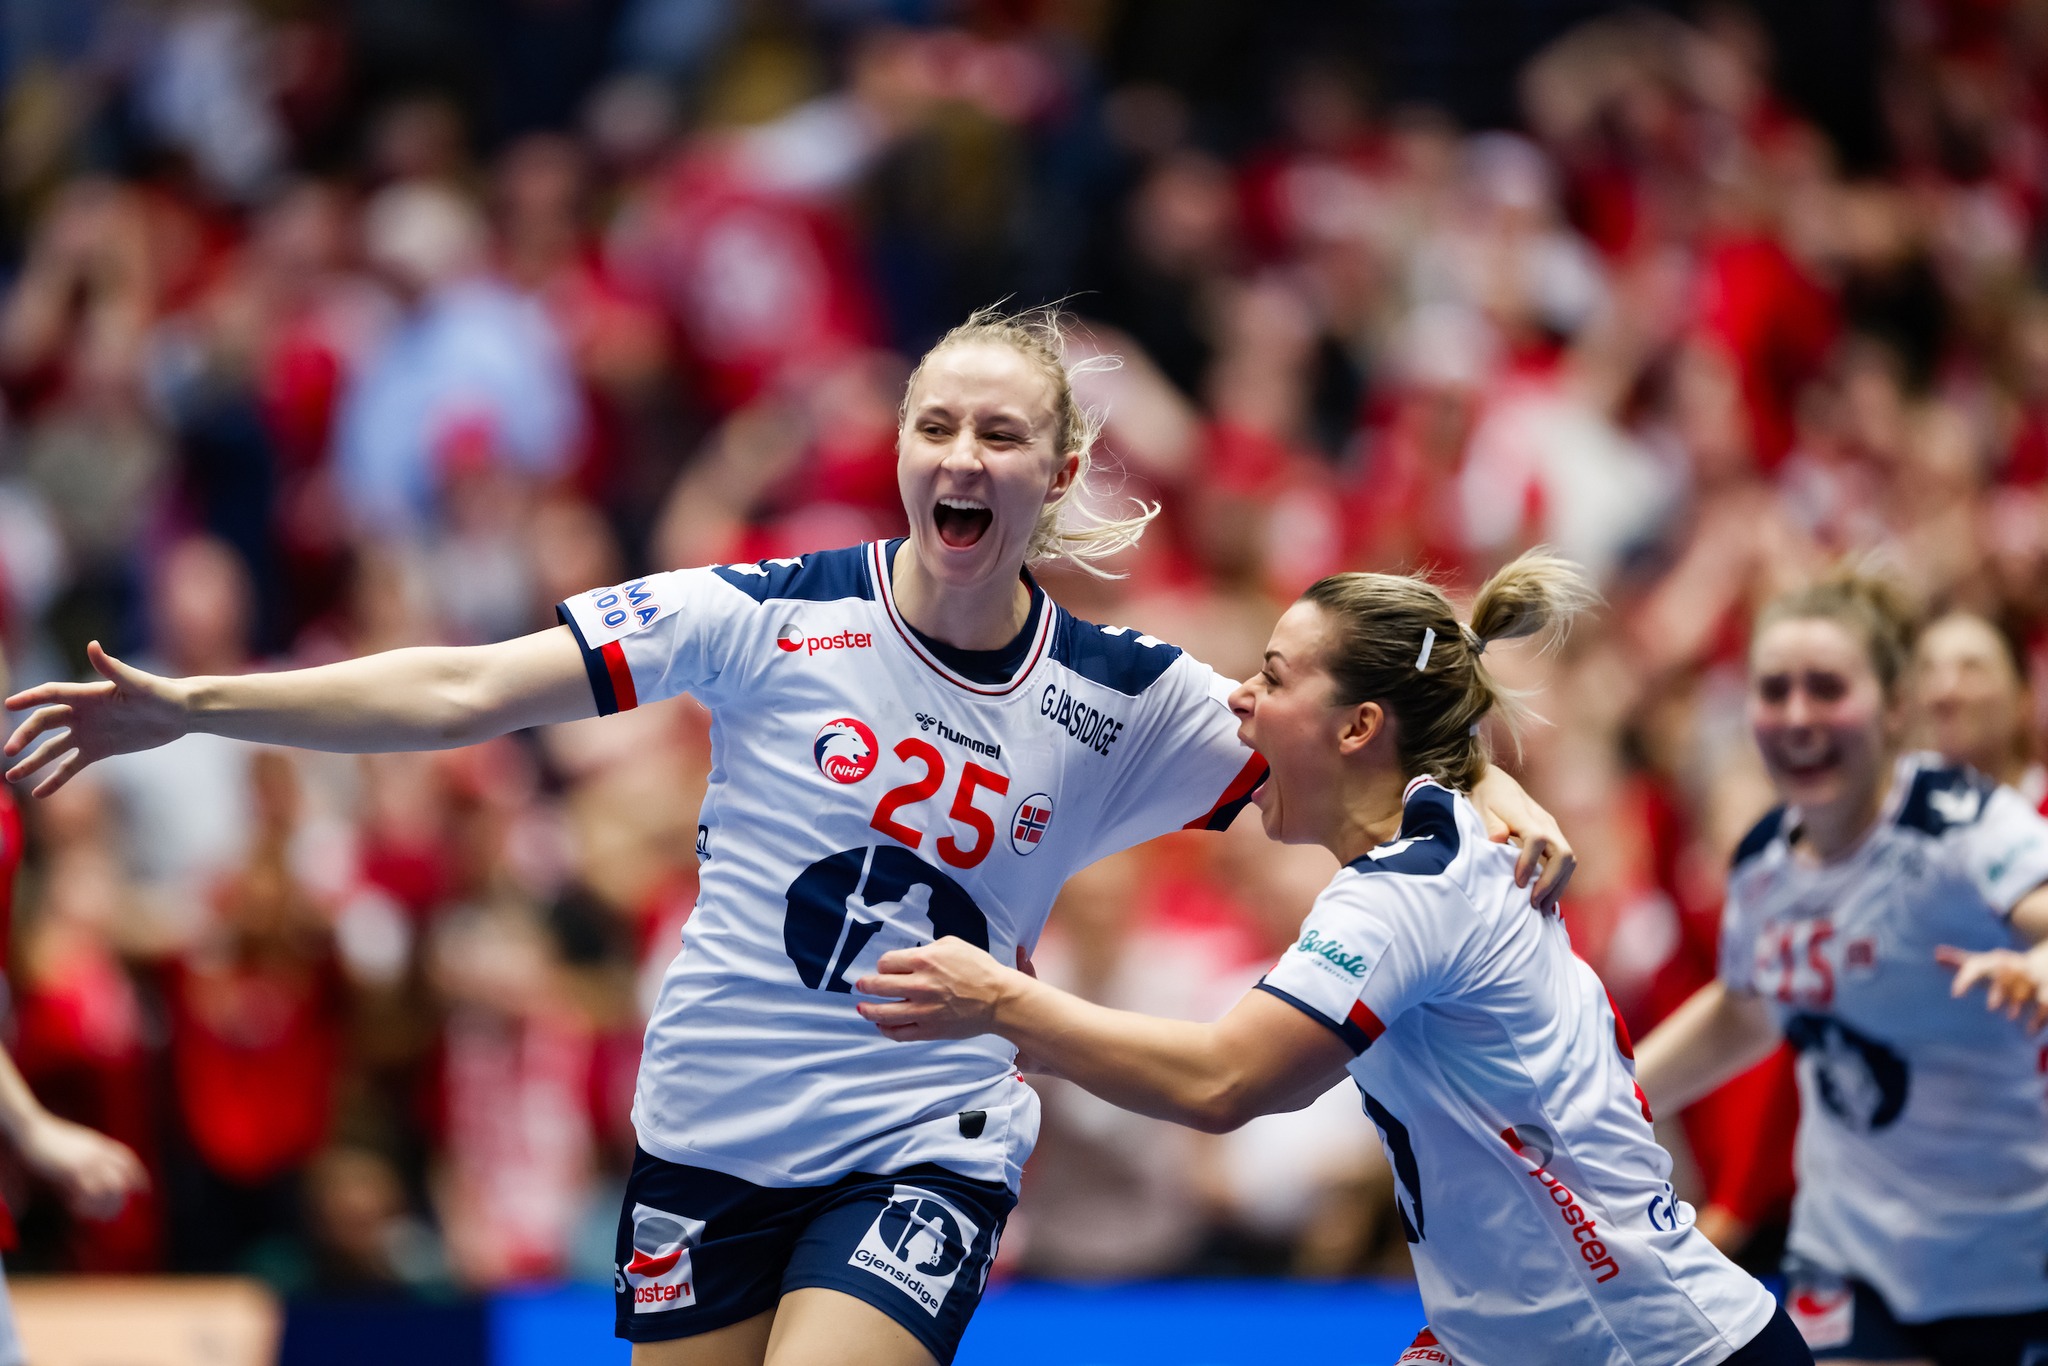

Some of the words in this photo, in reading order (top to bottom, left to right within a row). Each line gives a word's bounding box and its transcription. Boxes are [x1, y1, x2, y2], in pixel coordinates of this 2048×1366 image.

[624, 579, 660, 627] MA
[937, 720, 1002, 760] hummel
[833, 764, 865, 778] NHF
[869, 737, 1010, 870] 25
[1297, 929, 1368, 978] Batiste
[1528, 1167, 1620, 1284] posten
[854, 1249, 939, 1310] Gjensidige
